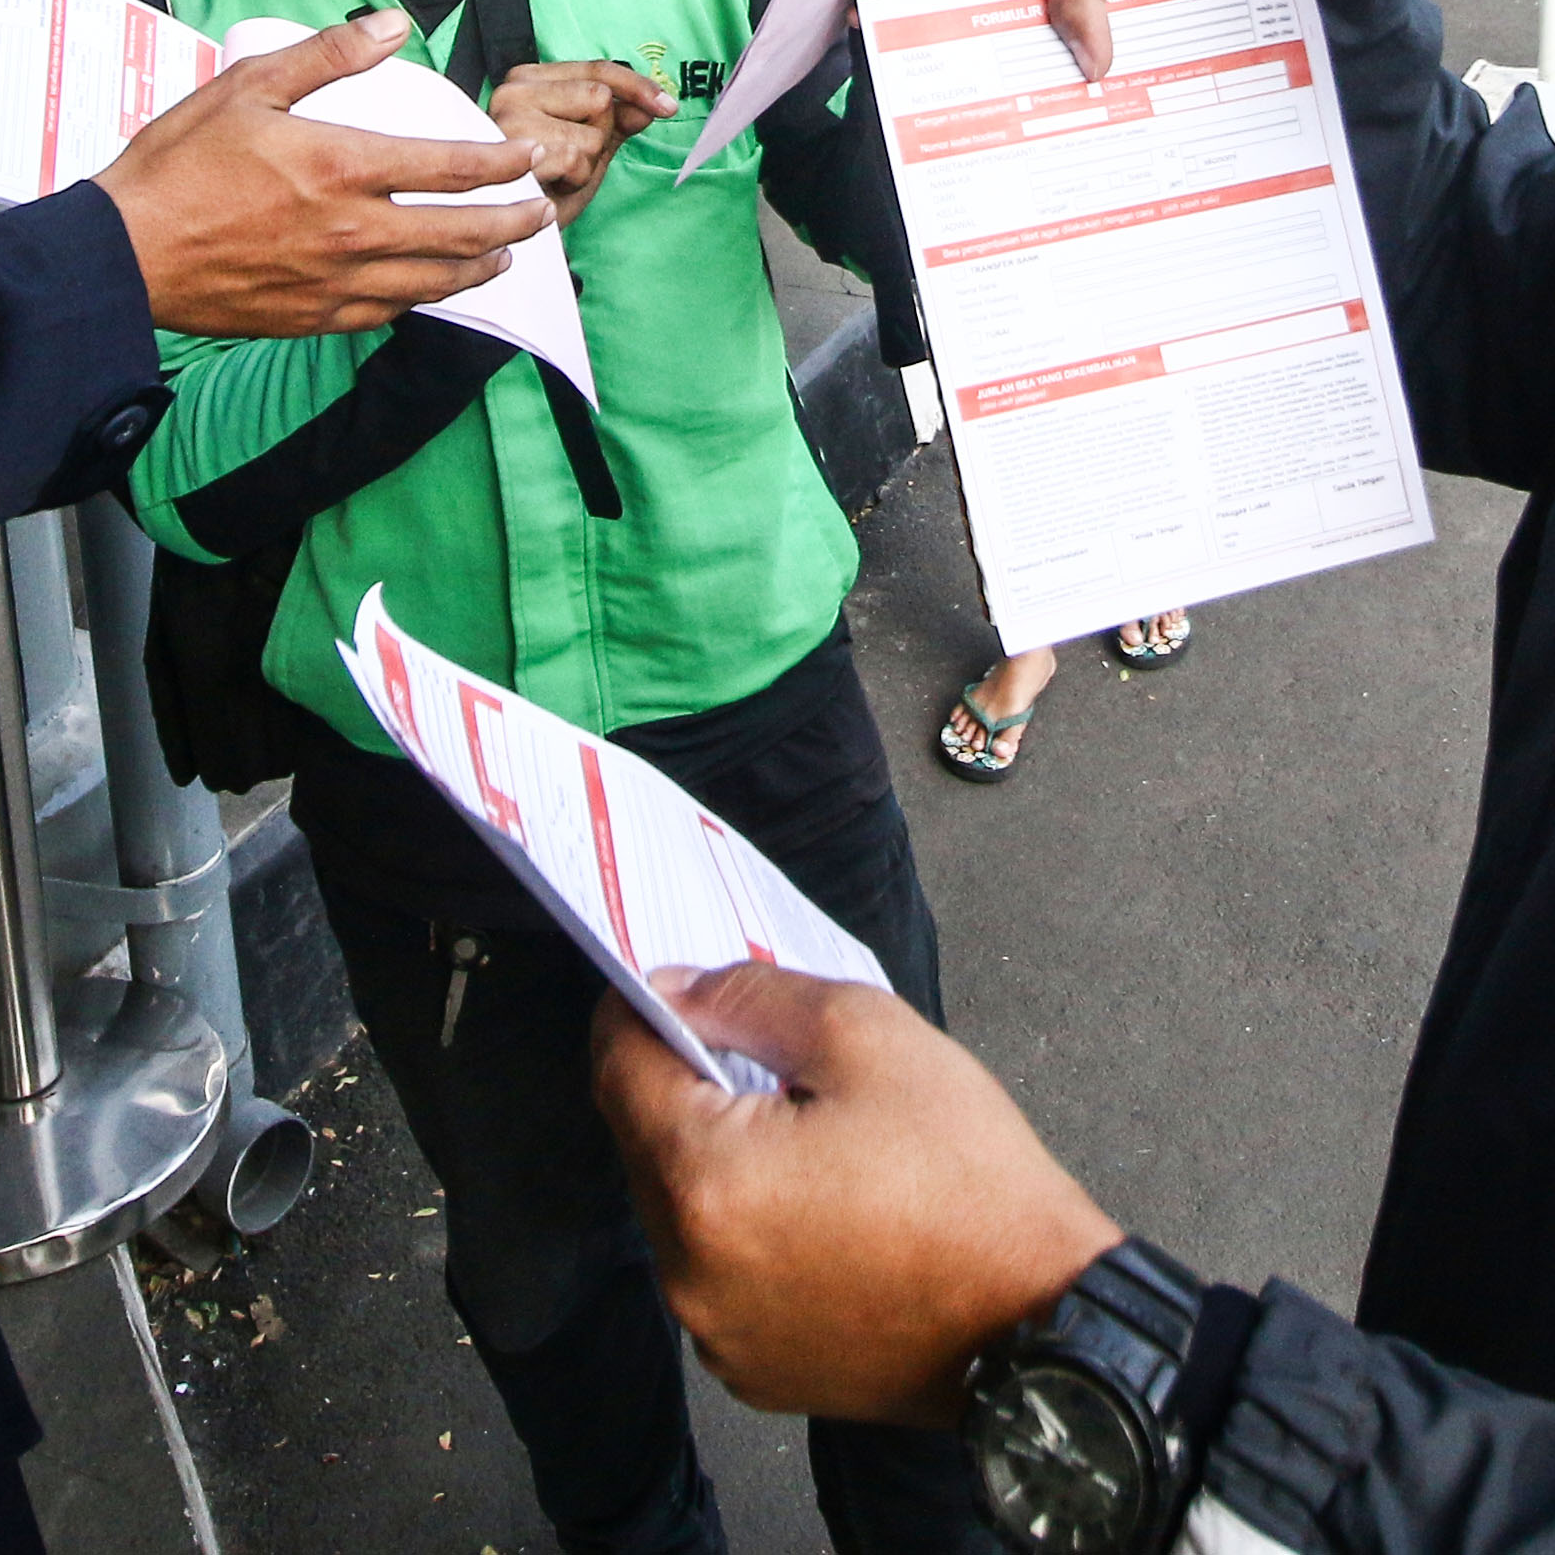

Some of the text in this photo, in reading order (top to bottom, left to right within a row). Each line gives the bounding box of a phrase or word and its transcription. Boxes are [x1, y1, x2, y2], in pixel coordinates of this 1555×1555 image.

[971, 4, 1043, 29] FORMULIR
[977, 382, 1015, 399] JUMLAH
[1037, 371, 1064, 384] YANG
